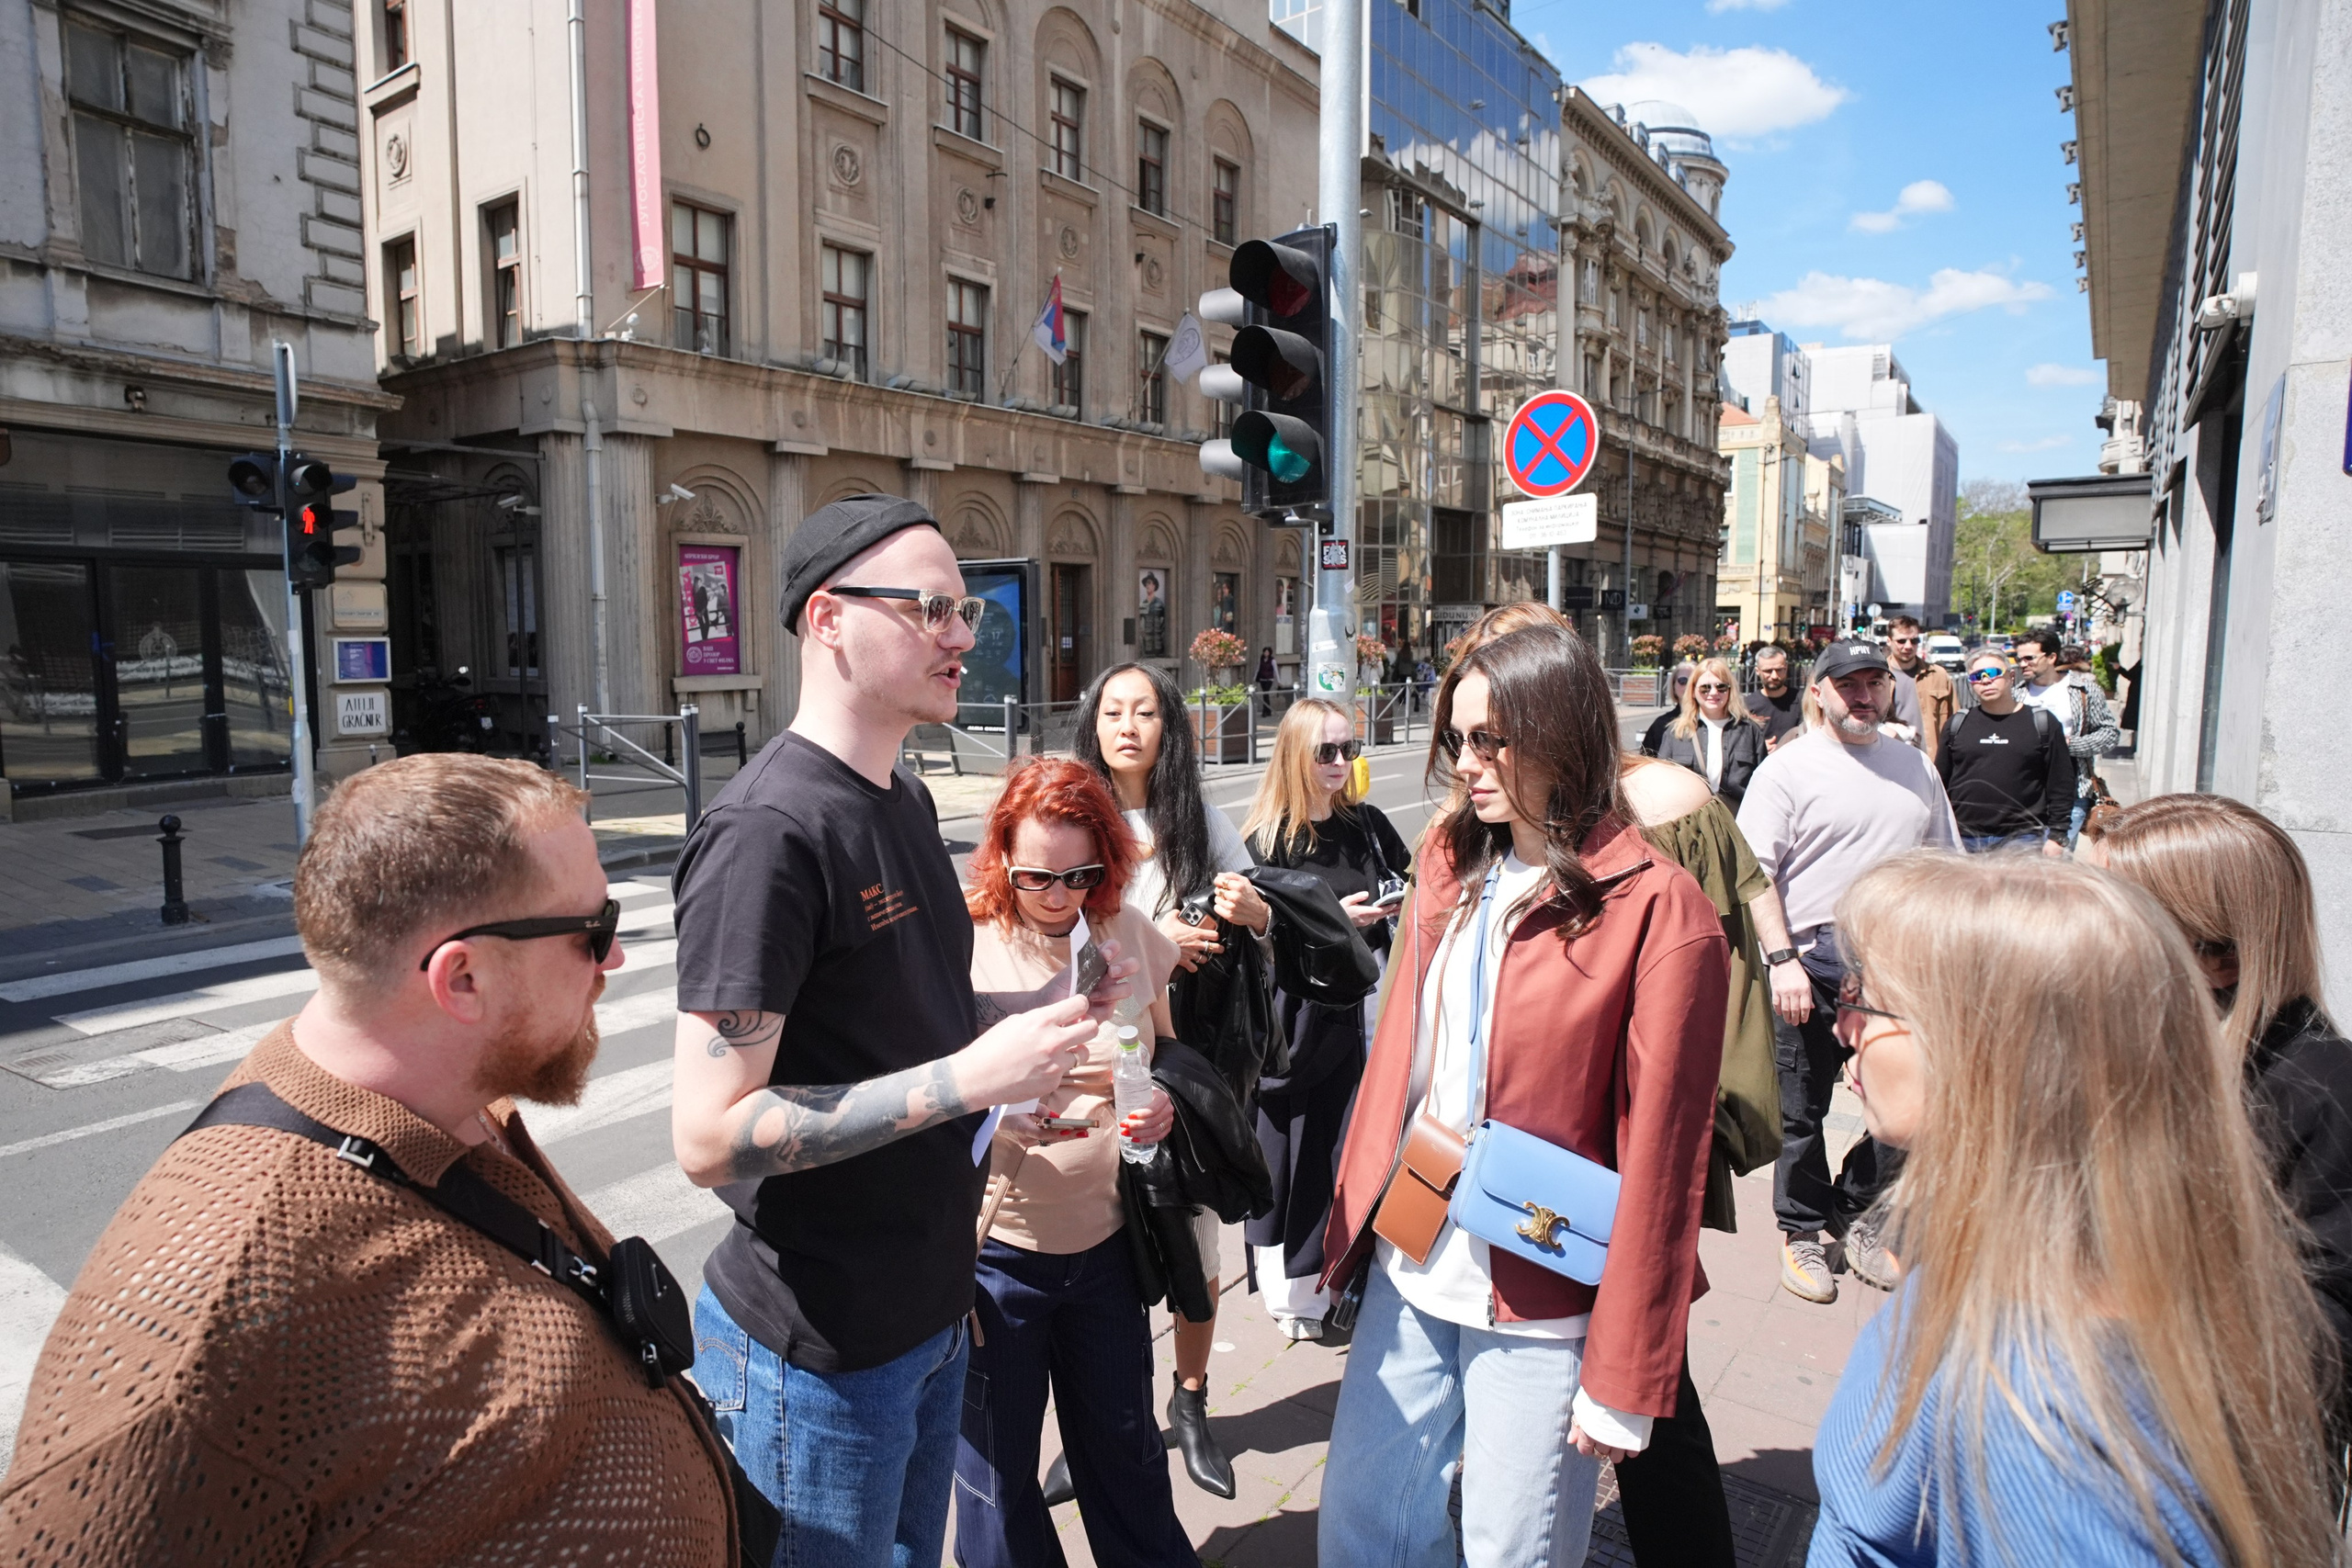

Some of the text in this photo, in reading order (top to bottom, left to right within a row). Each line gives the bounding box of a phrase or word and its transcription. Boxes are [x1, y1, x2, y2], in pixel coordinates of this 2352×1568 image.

[635, 87, 650, 228] ЈУГОСЛОВЕНСКА
[1323, 545, 1347, 555] FK
[1322, 555, 1348, 565] SS
